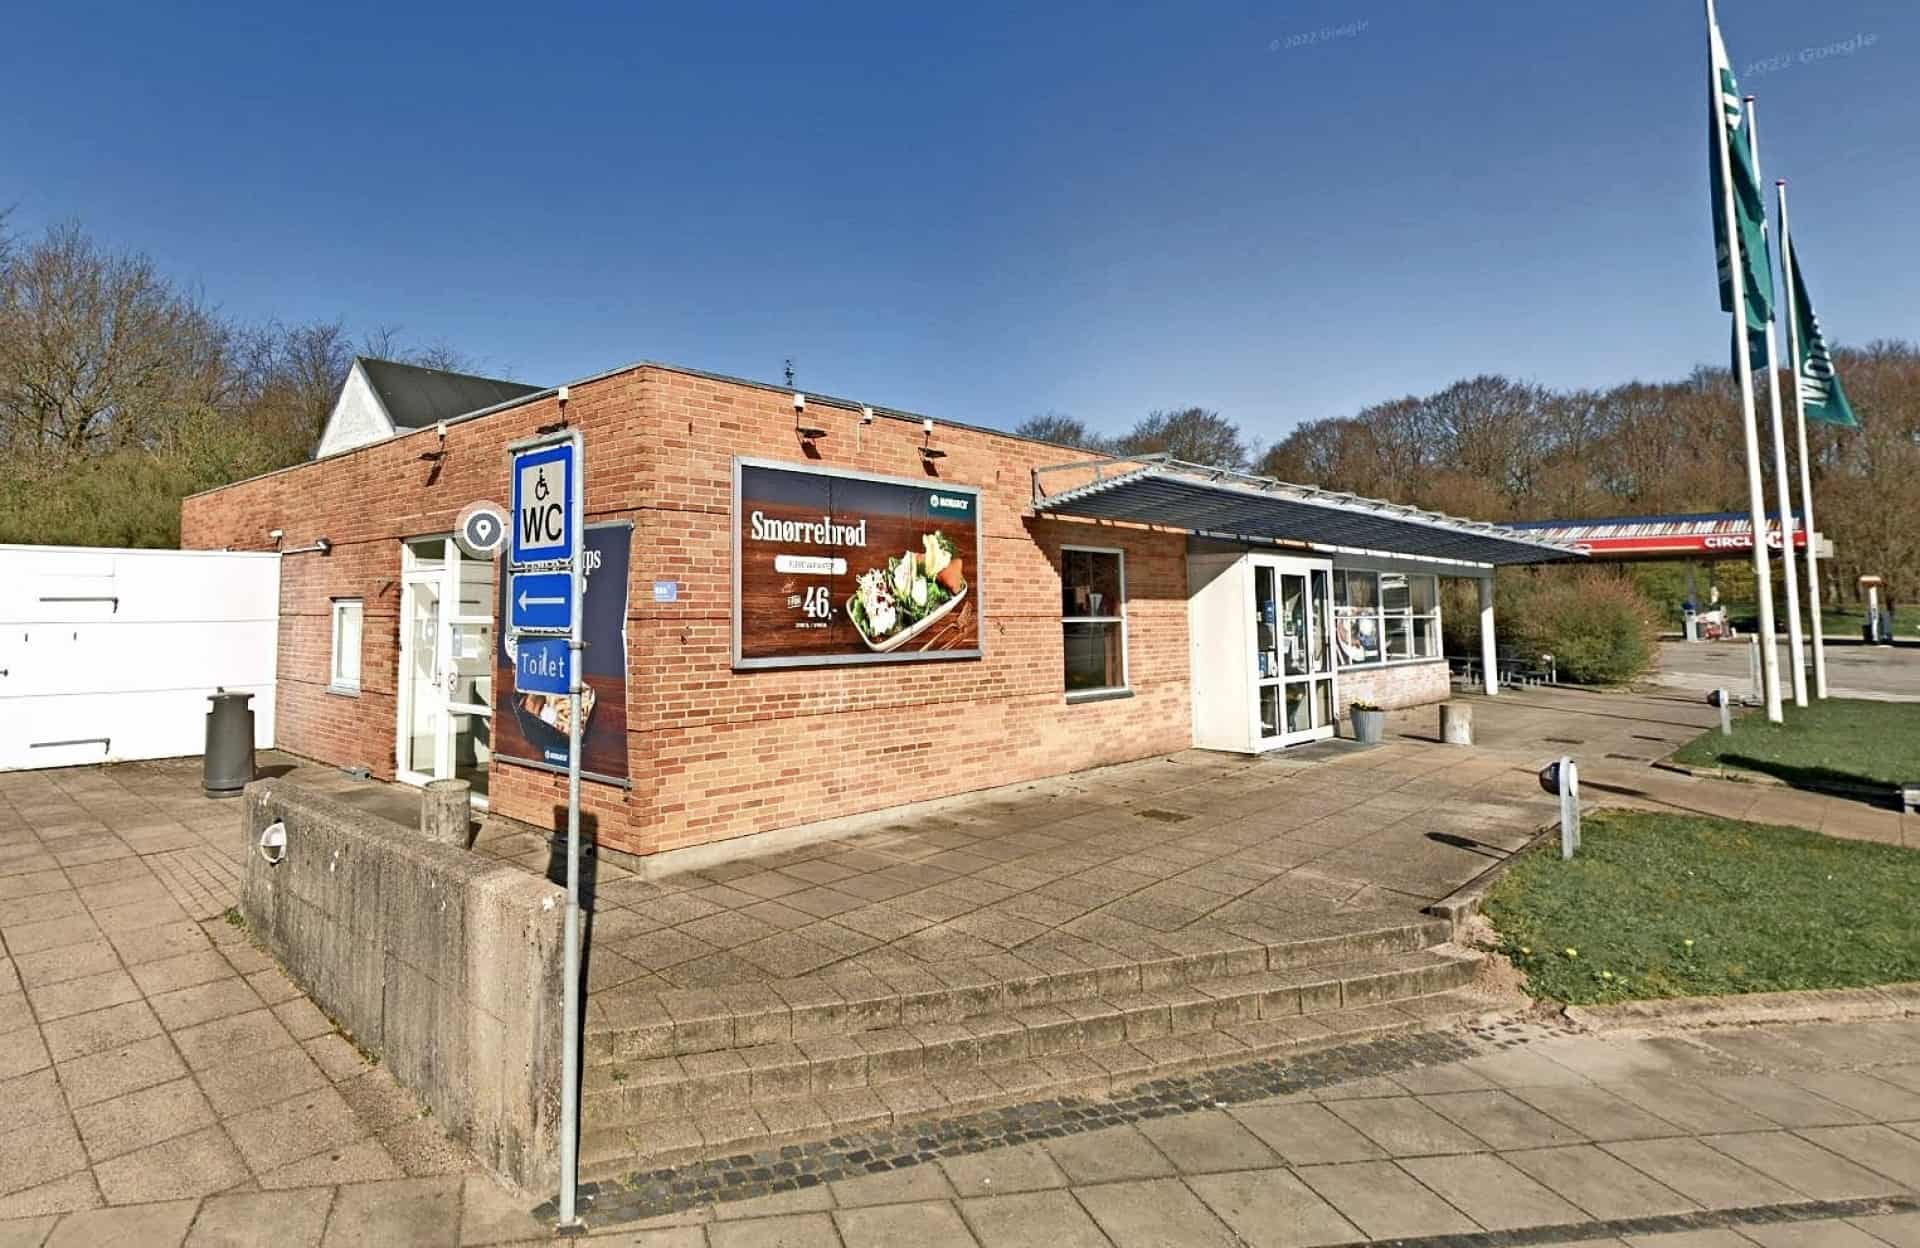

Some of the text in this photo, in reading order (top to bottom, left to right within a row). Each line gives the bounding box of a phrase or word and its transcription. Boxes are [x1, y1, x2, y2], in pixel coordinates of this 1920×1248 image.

[522, 504, 563, 543] WC
[751, 510, 867, 547] Smørrebrød
[1704, 535, 1753, 549] CIRCL
[521, 646, 566, 679] Toilet
